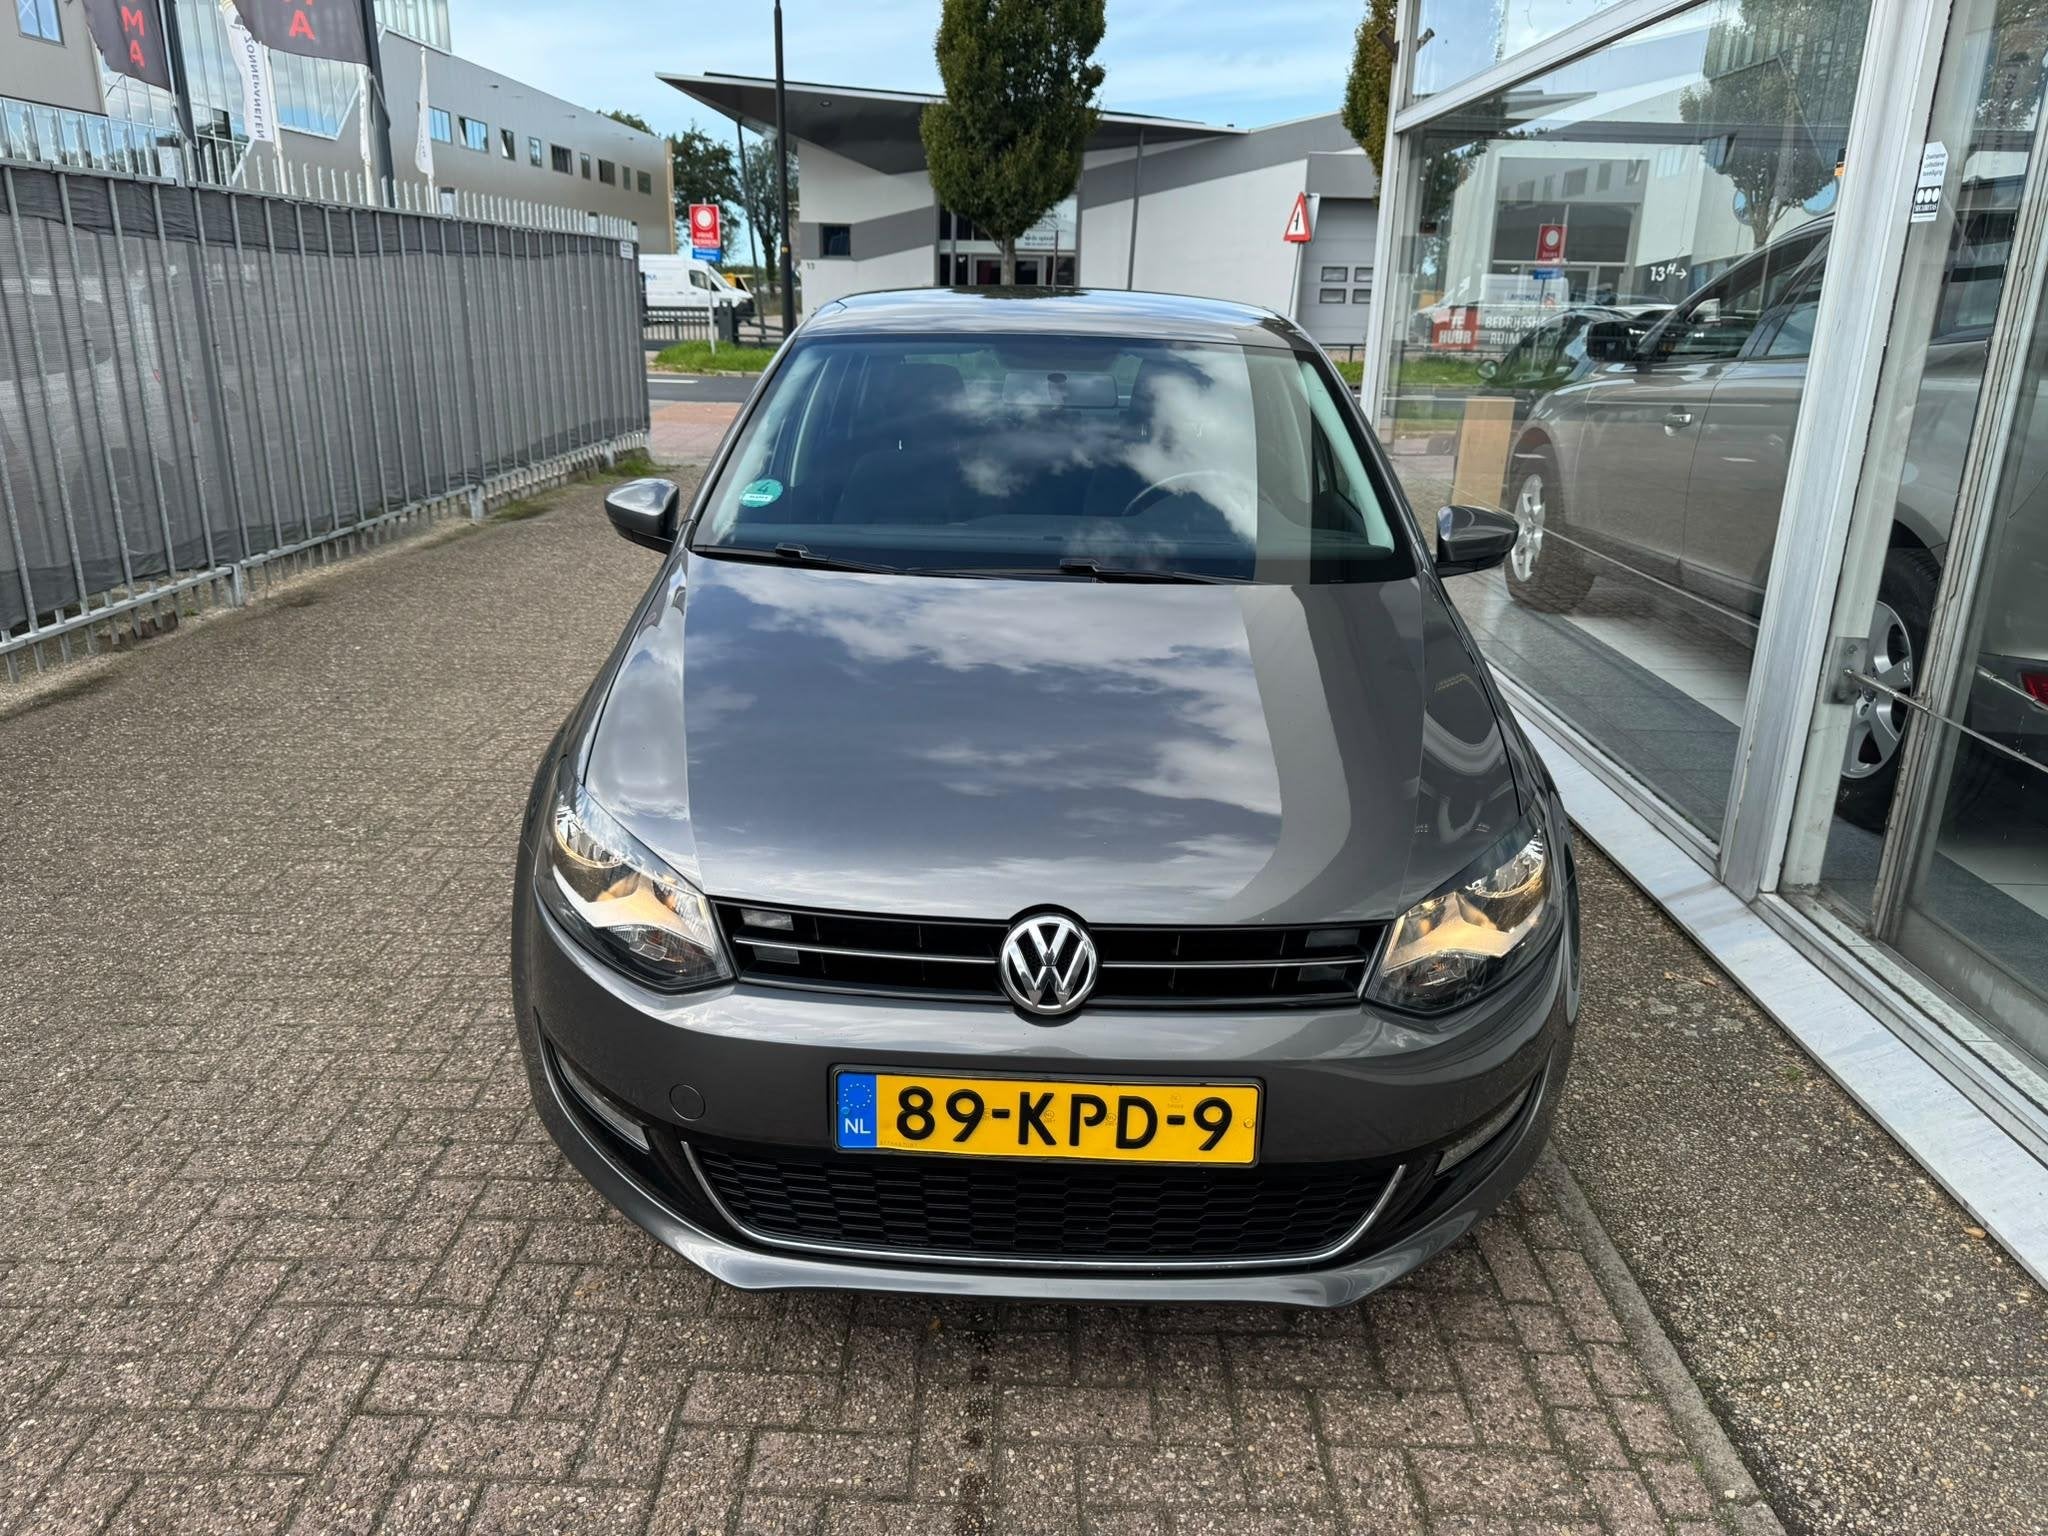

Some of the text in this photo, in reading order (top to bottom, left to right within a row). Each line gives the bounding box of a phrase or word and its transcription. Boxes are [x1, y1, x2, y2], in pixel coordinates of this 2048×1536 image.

[1451, 316, 1465, 329] TE
[1439, 331, 1472, 345] HUUR
[896, 1086, 1233, 1151] 89-KPD-9
[844, 1118, 871, 1135] NL
